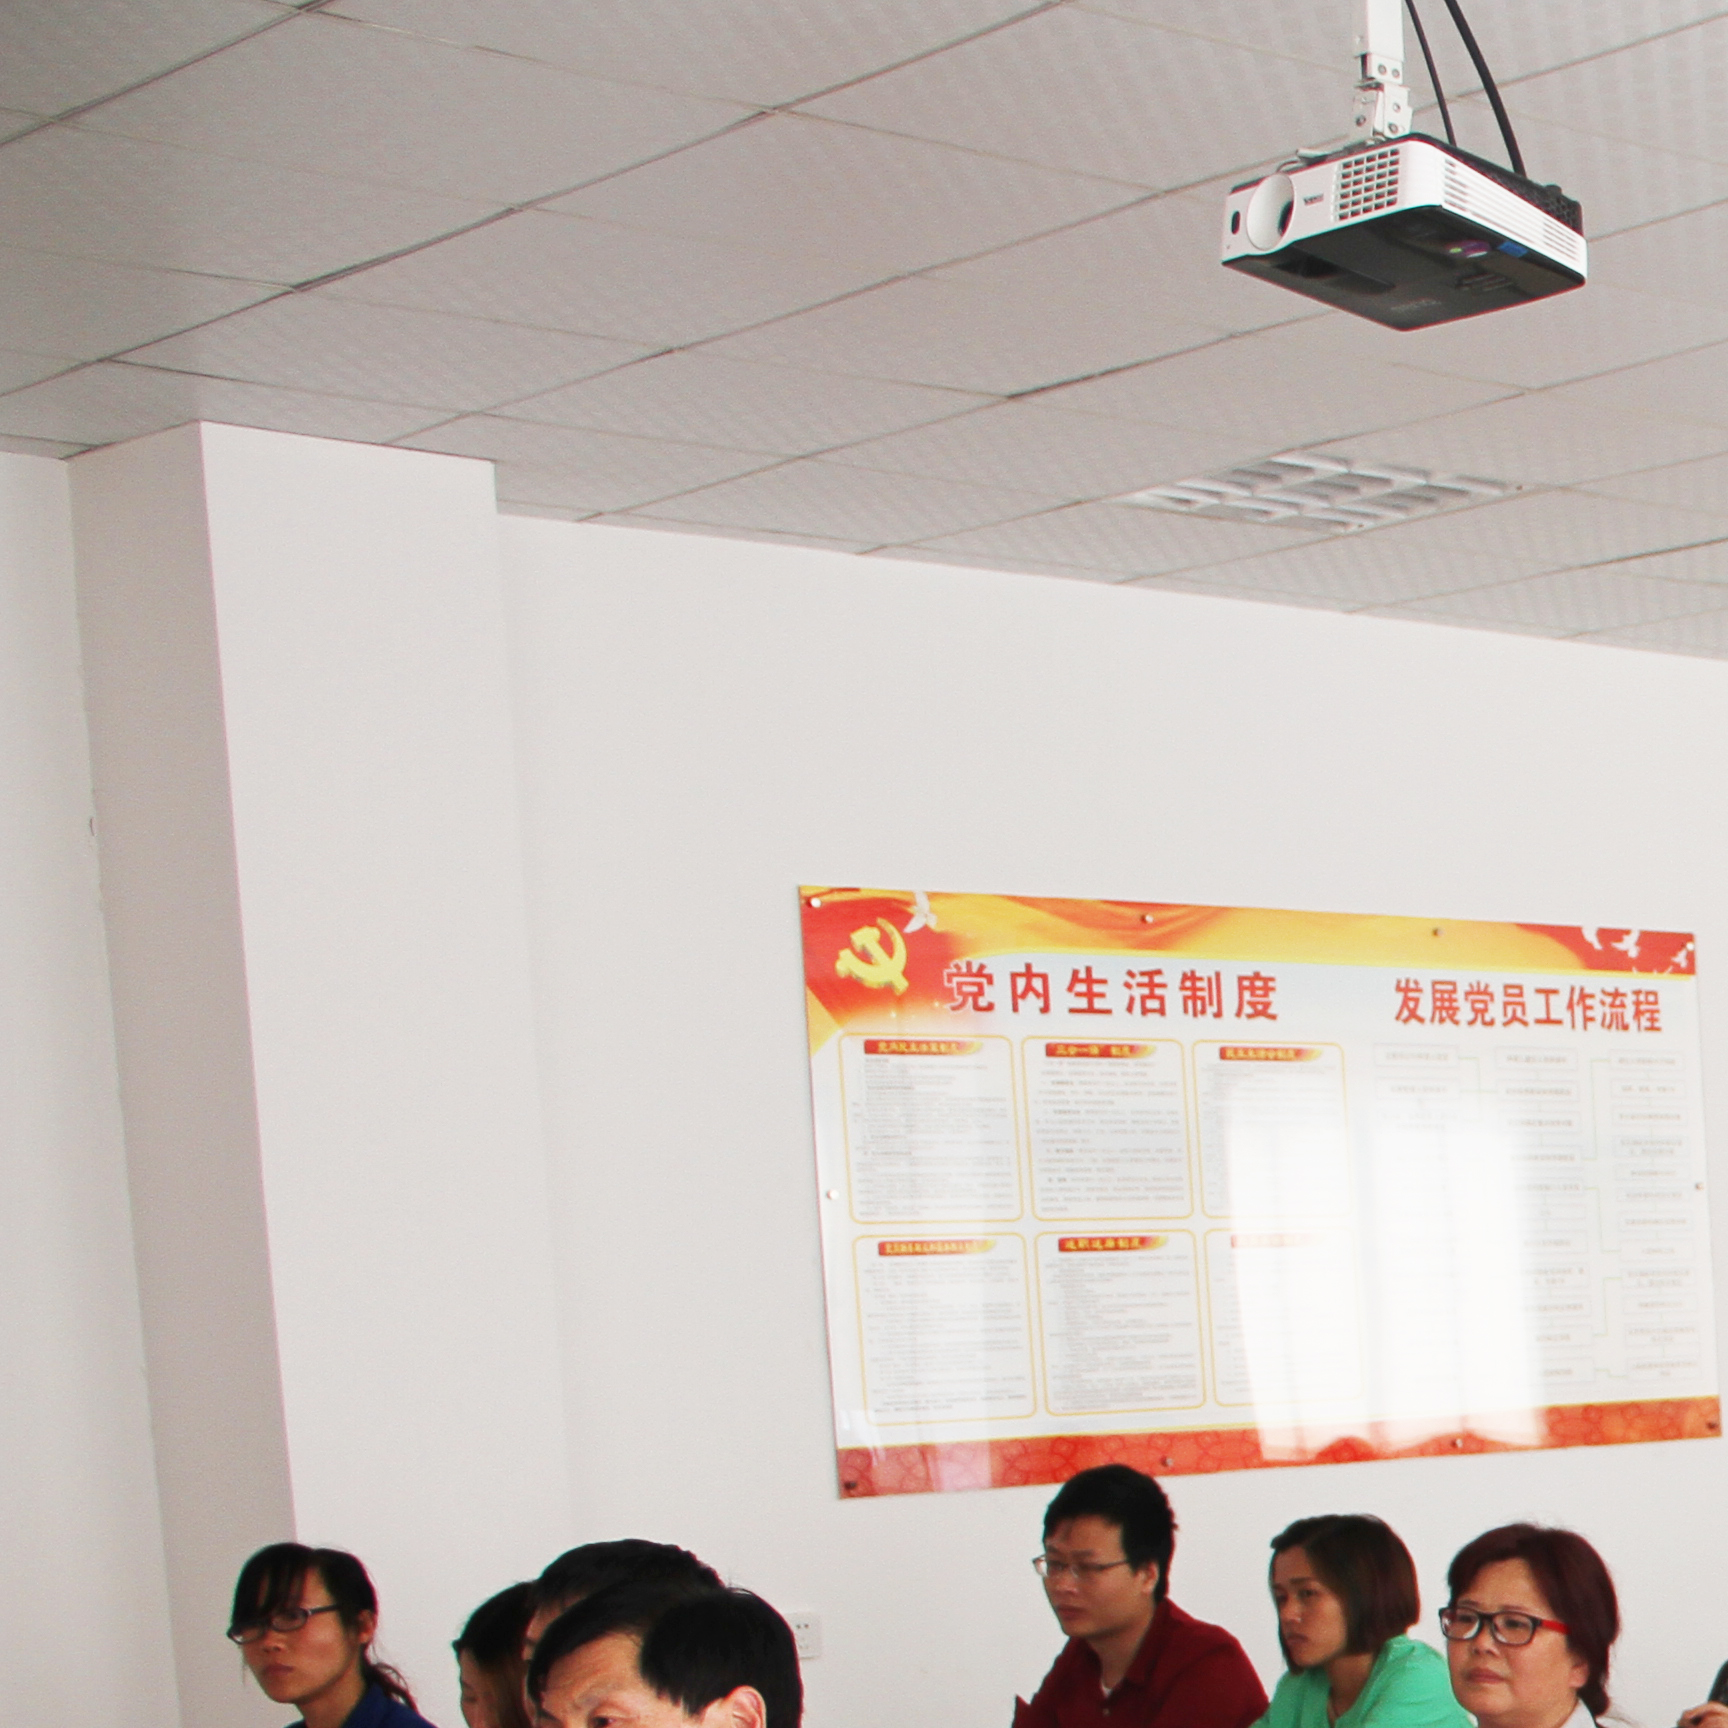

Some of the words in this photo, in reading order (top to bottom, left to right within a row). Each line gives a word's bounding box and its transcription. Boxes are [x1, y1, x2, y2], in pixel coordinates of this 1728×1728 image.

[945, 961, 1278, 1020] 党内生活制度
[1395, 977, 1662, 1032] 发展党员工作流程
